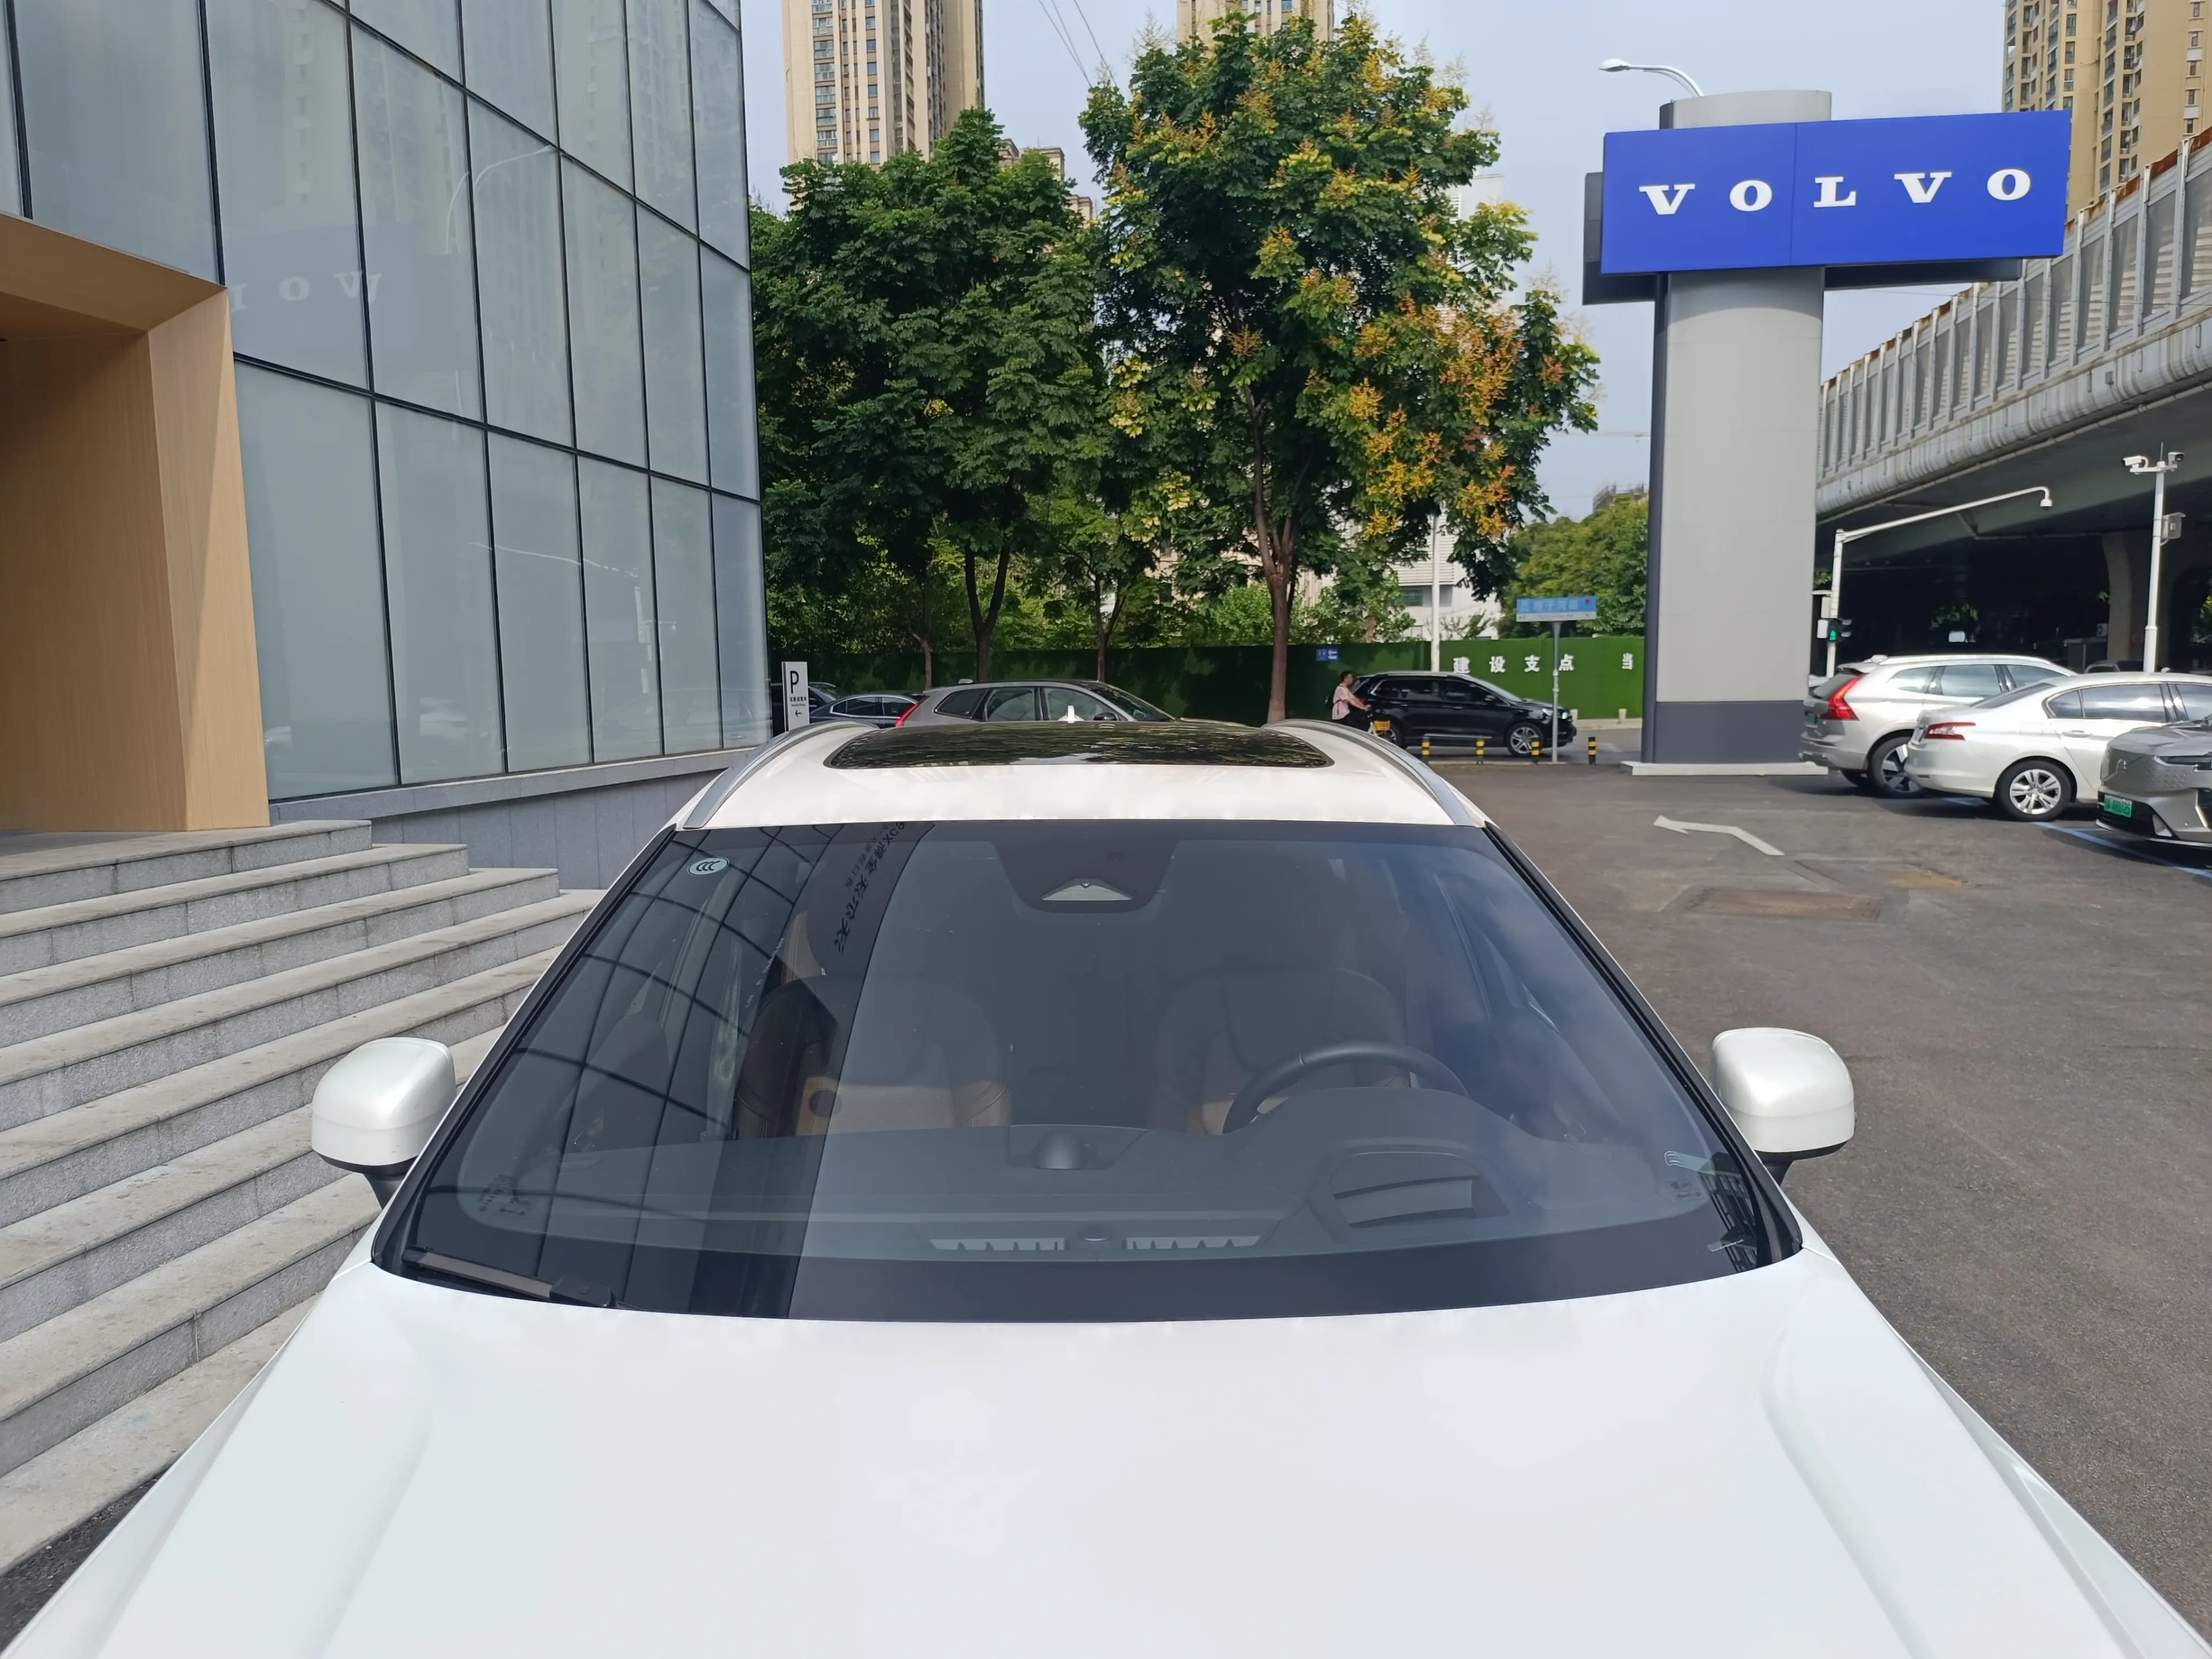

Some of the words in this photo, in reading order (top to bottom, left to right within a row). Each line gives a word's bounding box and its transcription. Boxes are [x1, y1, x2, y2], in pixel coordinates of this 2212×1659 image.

[1638, 168, 2032, 215] VOLVO
[1453, 654, 1575, 674] 建设支点
[790, 670, 799, 694] P
